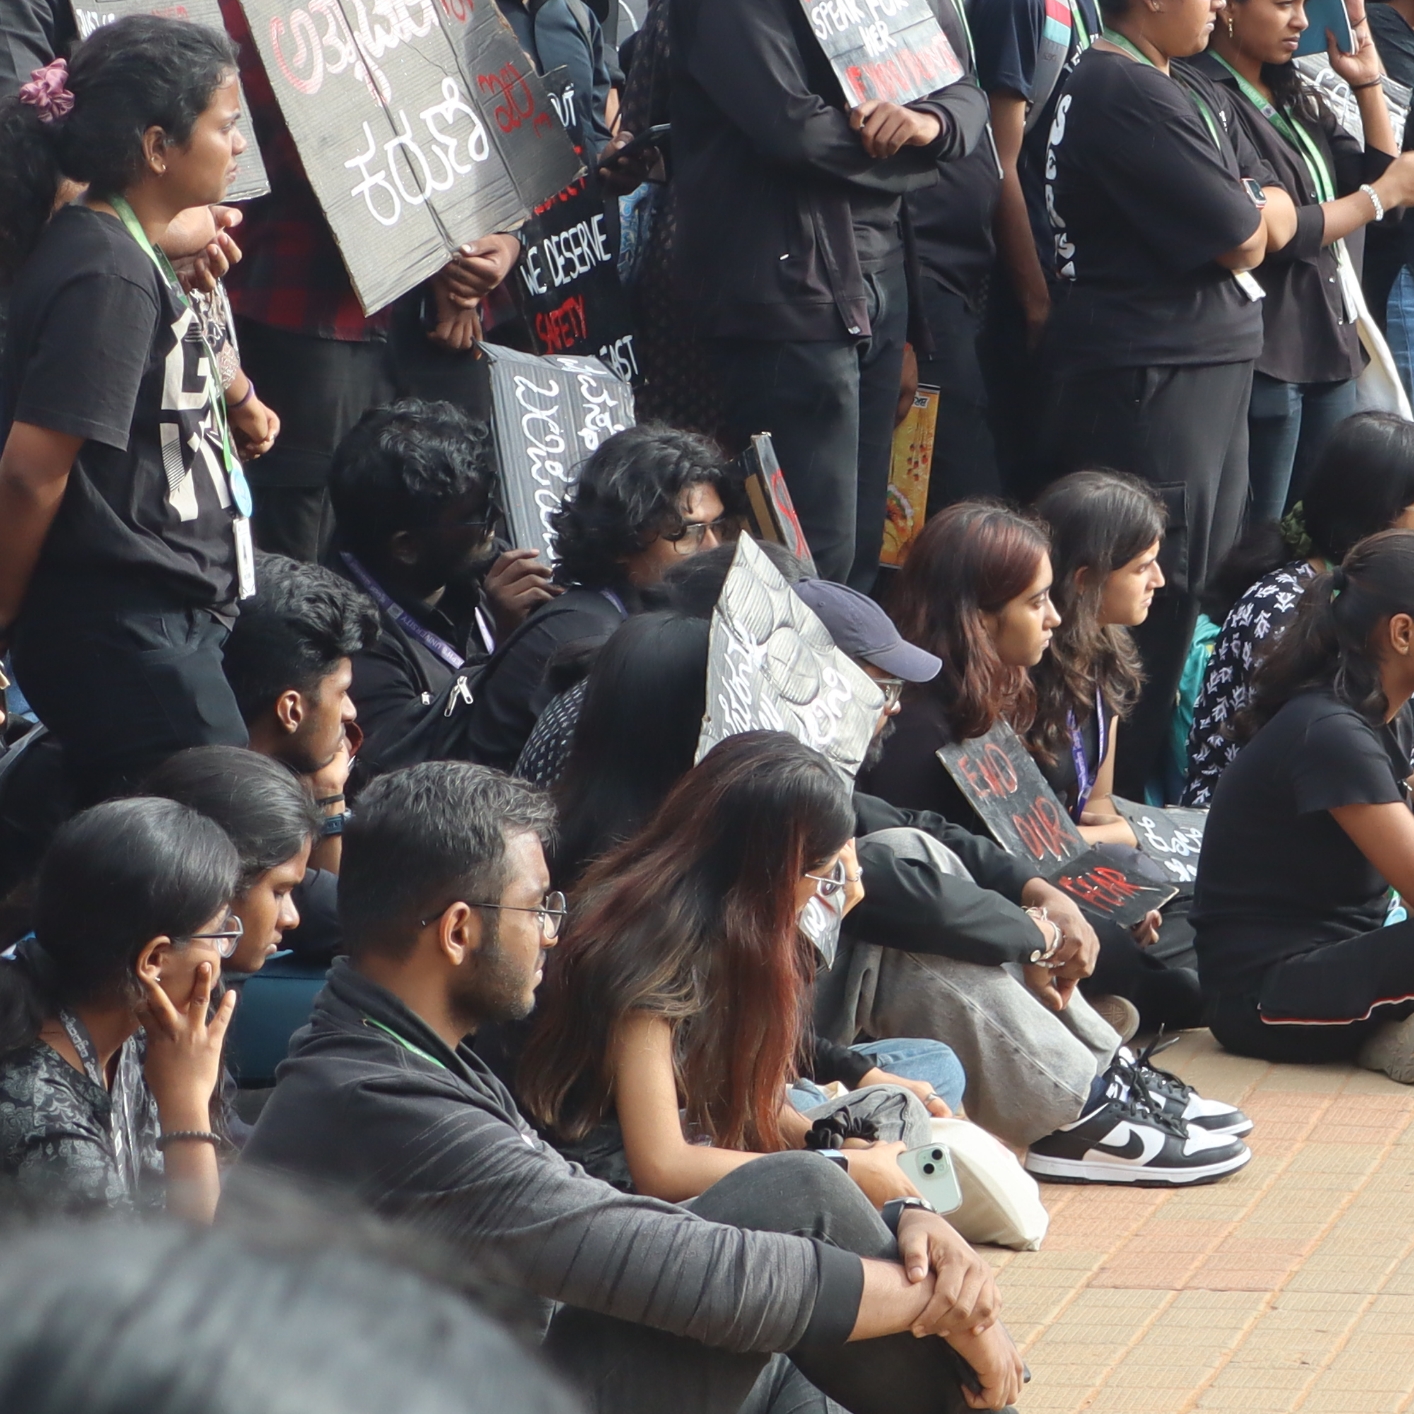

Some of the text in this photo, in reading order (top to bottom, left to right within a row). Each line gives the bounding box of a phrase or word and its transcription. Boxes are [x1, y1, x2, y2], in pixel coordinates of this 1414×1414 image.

[859, 21, 897, 57] HER
[520, 213, 611, 296] WE DESERVE
[536, 294, 587, 354] SAFETY
[957, 742, 1018, 800] END
